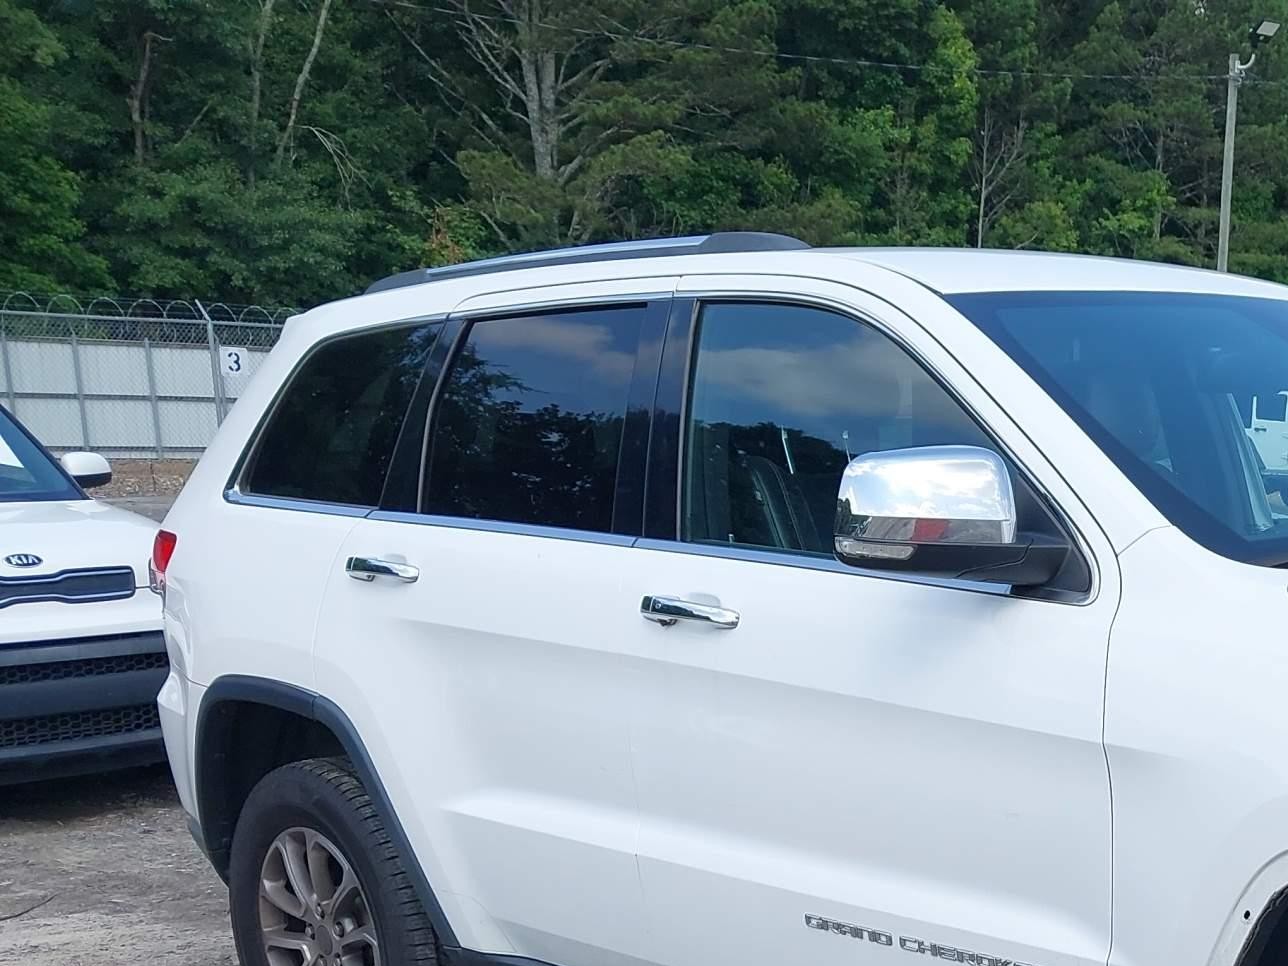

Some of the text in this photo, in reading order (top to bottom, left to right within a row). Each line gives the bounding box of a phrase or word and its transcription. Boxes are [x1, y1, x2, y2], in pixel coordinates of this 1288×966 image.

[227, 351, 241, 373] 3
[8, 555, 39, 566] KIA
[804, 912, 894, 946] GRAND
